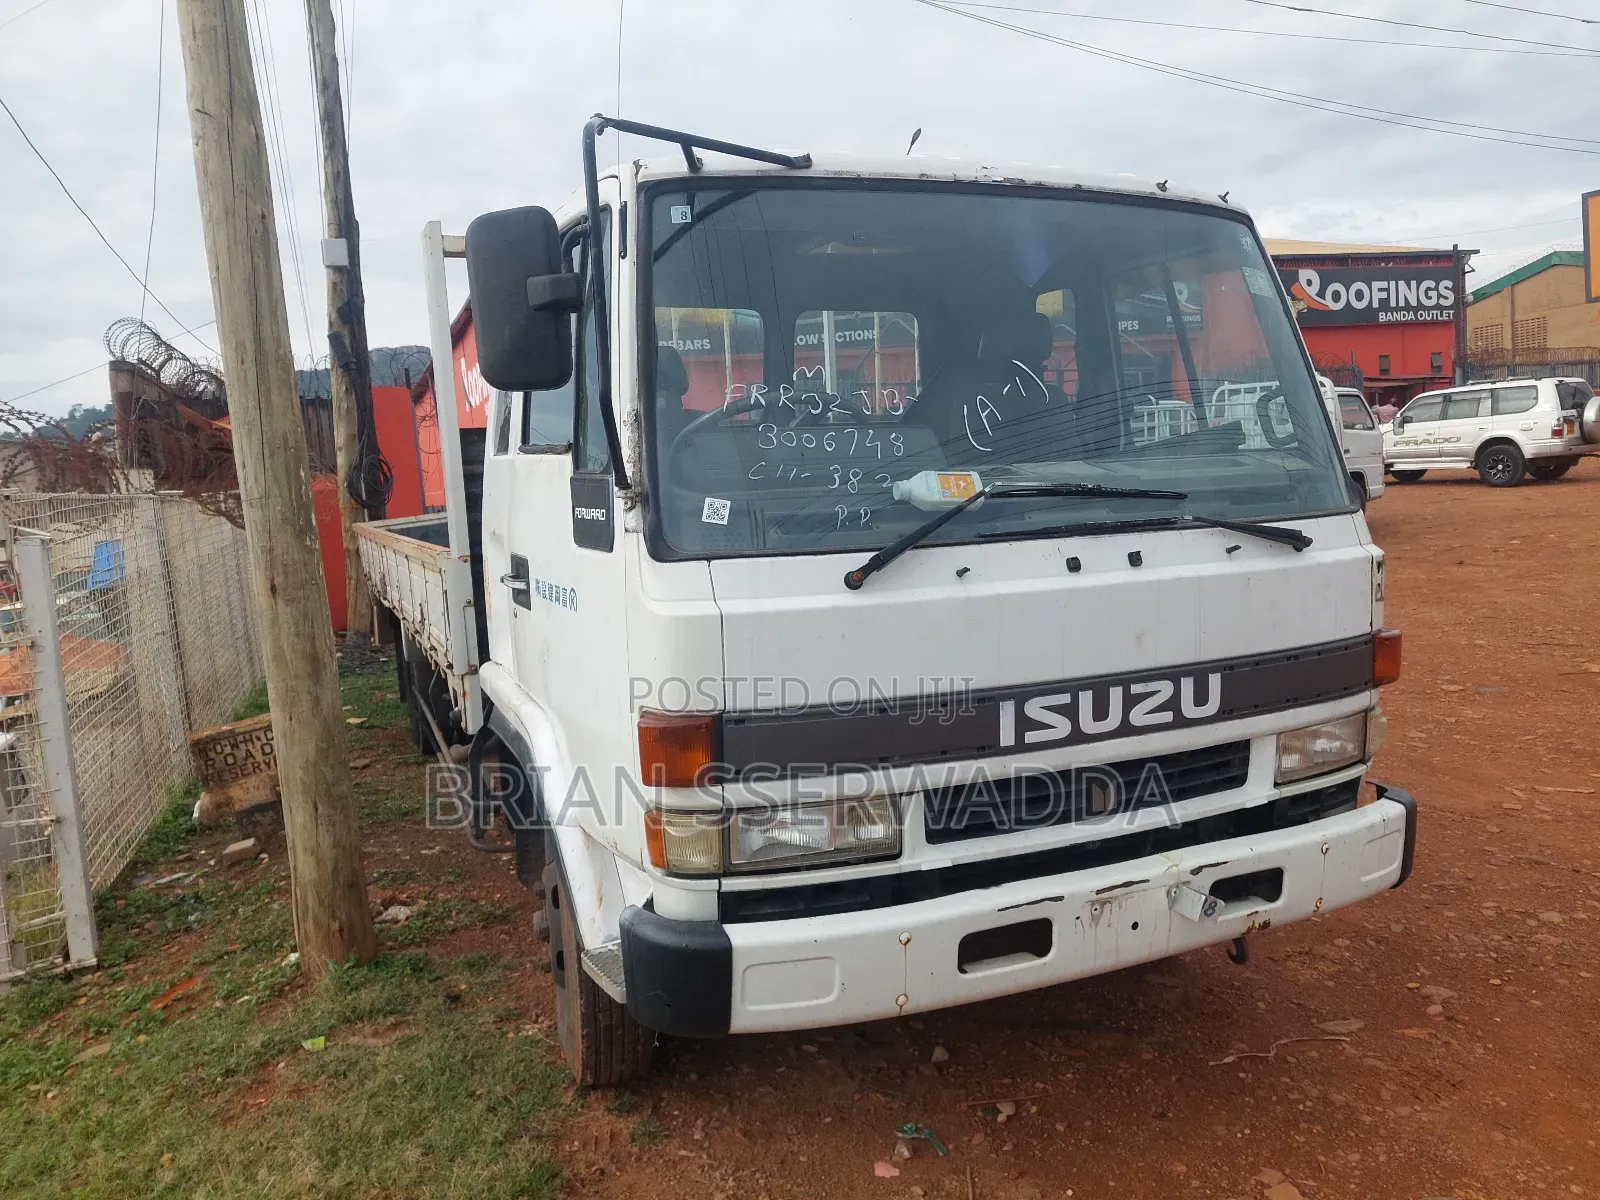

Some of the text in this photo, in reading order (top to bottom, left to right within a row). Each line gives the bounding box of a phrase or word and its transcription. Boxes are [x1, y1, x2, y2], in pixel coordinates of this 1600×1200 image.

[680, 210, 688, 221] 8
[1297, 269, 1455, 311] ROOFINGS
[1378, 310, 1455, 322] BANDA OUTLET
[794, 333, 819, 346] OW
[1393, 436, 1461, 447] PRADO
[574, 507, 606, 521] FORWARD
[1000, 672, 1221, 747] ISUZU
